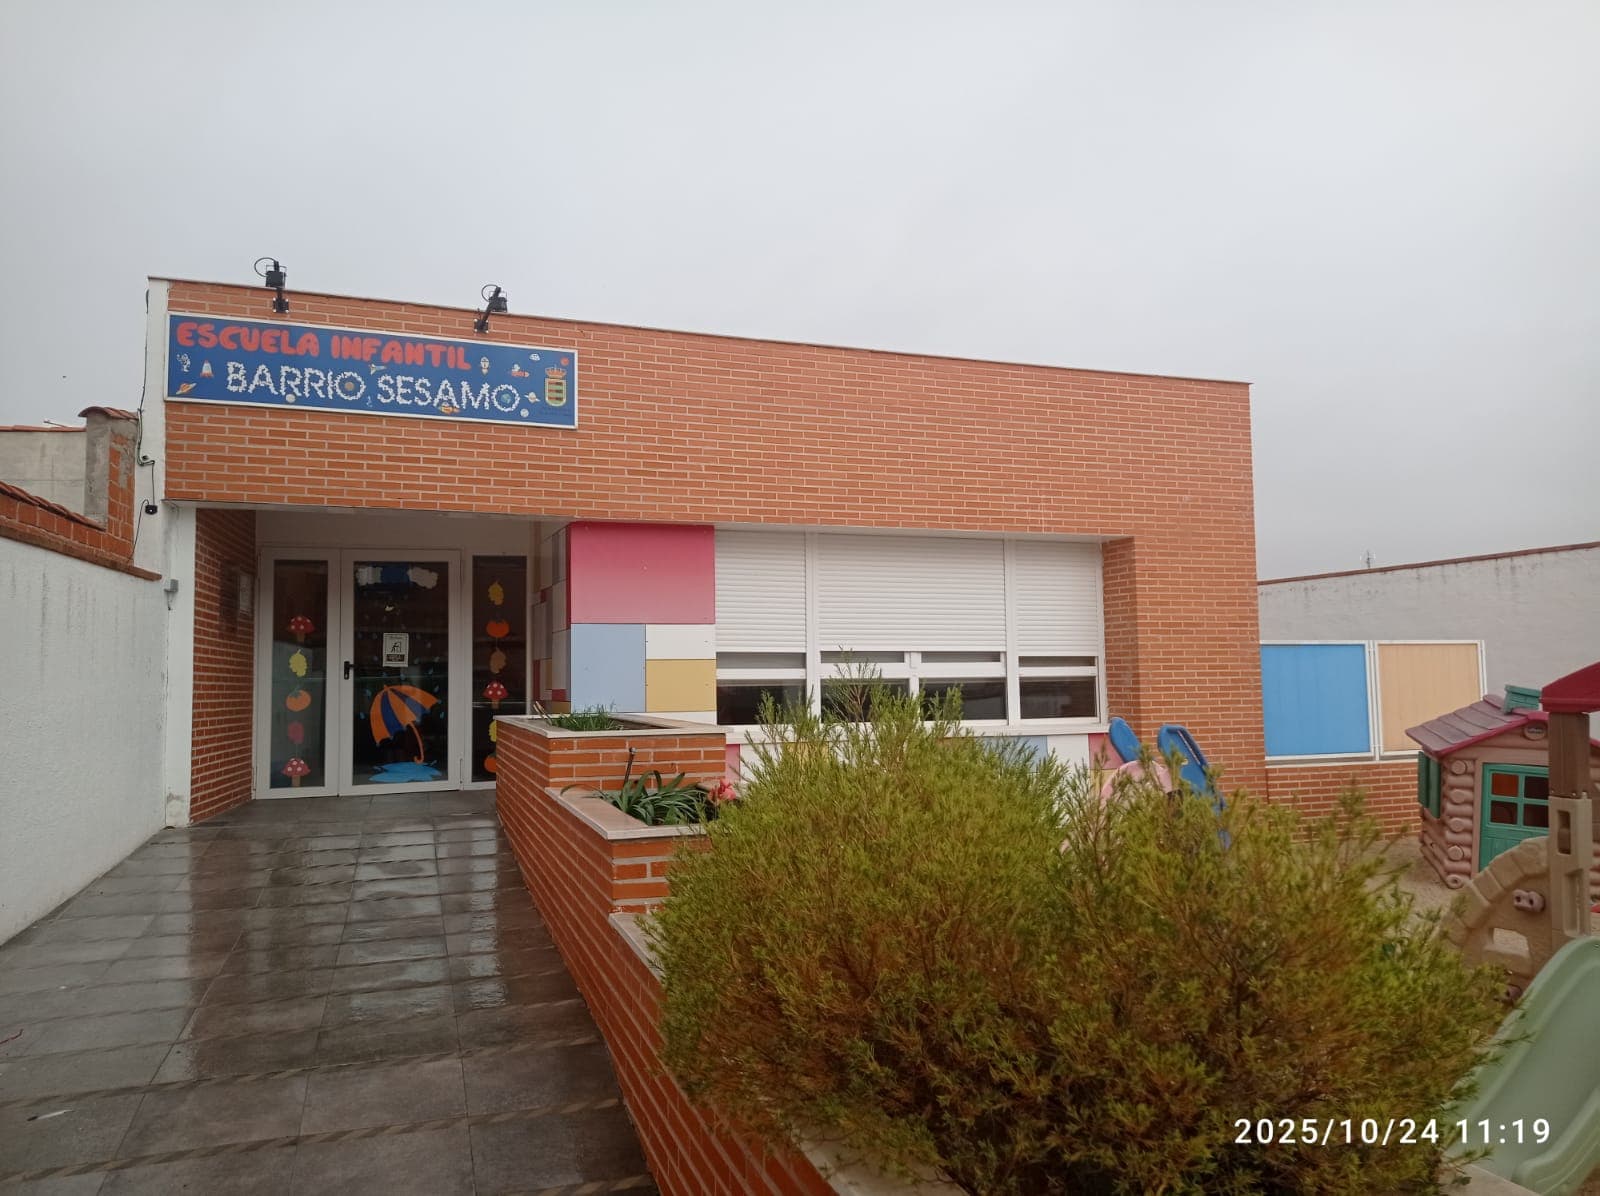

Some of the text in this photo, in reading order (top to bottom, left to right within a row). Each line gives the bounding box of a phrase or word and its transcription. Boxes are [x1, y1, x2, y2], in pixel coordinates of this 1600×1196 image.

[177, 322, 472, 370] ESCUELA INFANTIL
[225, 361, 520, 412] BARRIO SESAMO
